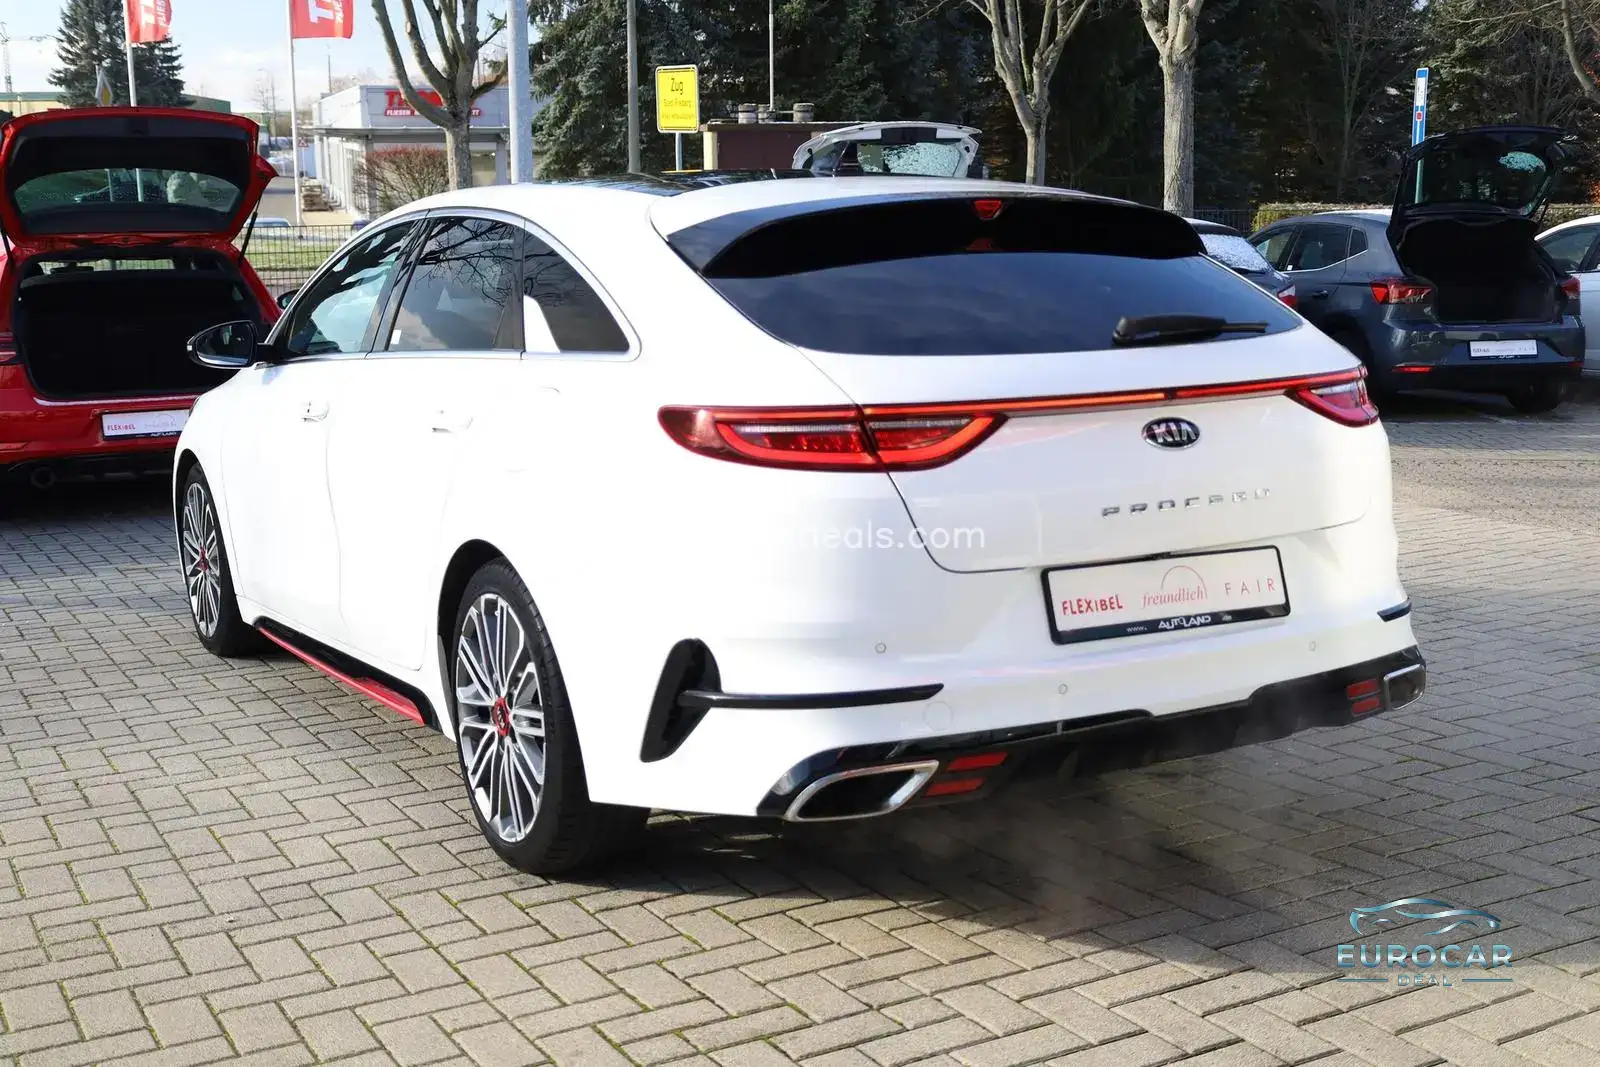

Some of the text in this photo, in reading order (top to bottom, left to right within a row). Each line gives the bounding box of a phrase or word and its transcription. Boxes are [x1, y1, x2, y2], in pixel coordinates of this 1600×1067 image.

[671, 77, 684, 95] Zug
[1152, 421, 1196, 443] KIA
[1061, 577, 1276, 616] FLEXIBEL freundlich FAIR
[1158, 615, 1212, 631] AUTOLAND
